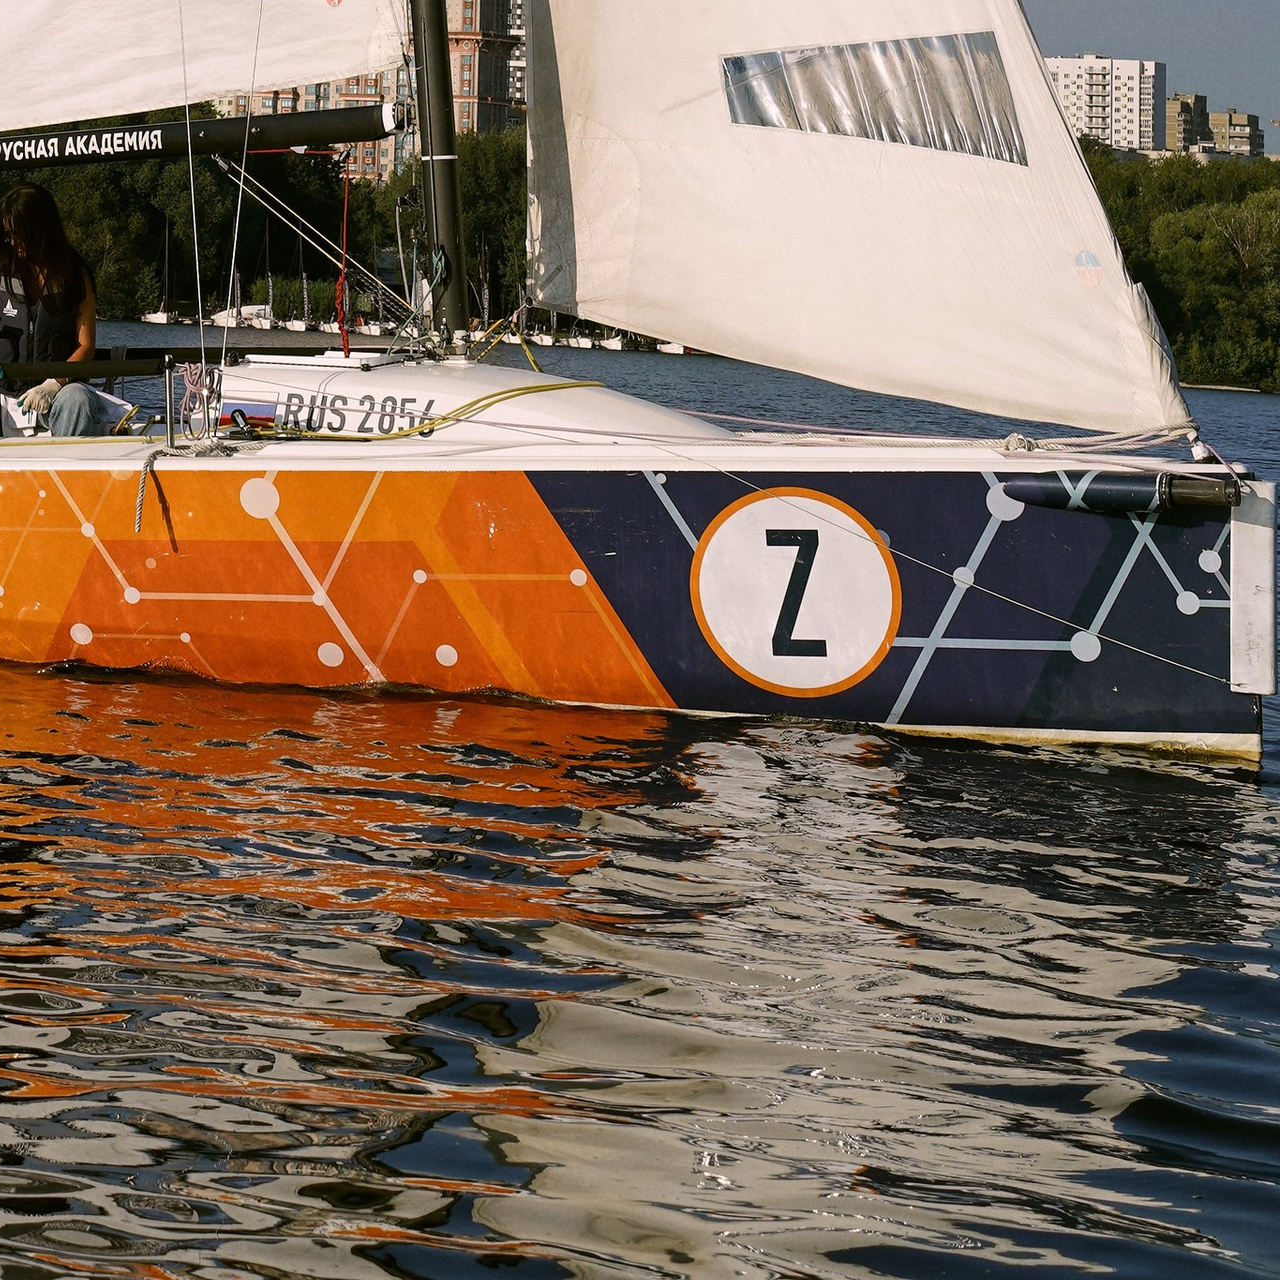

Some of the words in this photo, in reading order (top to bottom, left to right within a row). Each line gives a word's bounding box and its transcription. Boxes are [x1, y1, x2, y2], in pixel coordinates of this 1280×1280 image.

[64, 130, 163, 156] АКАДЕМИЯ
[284, 393, 347, 433] RUS
[765, 528, 827, 658] Z
